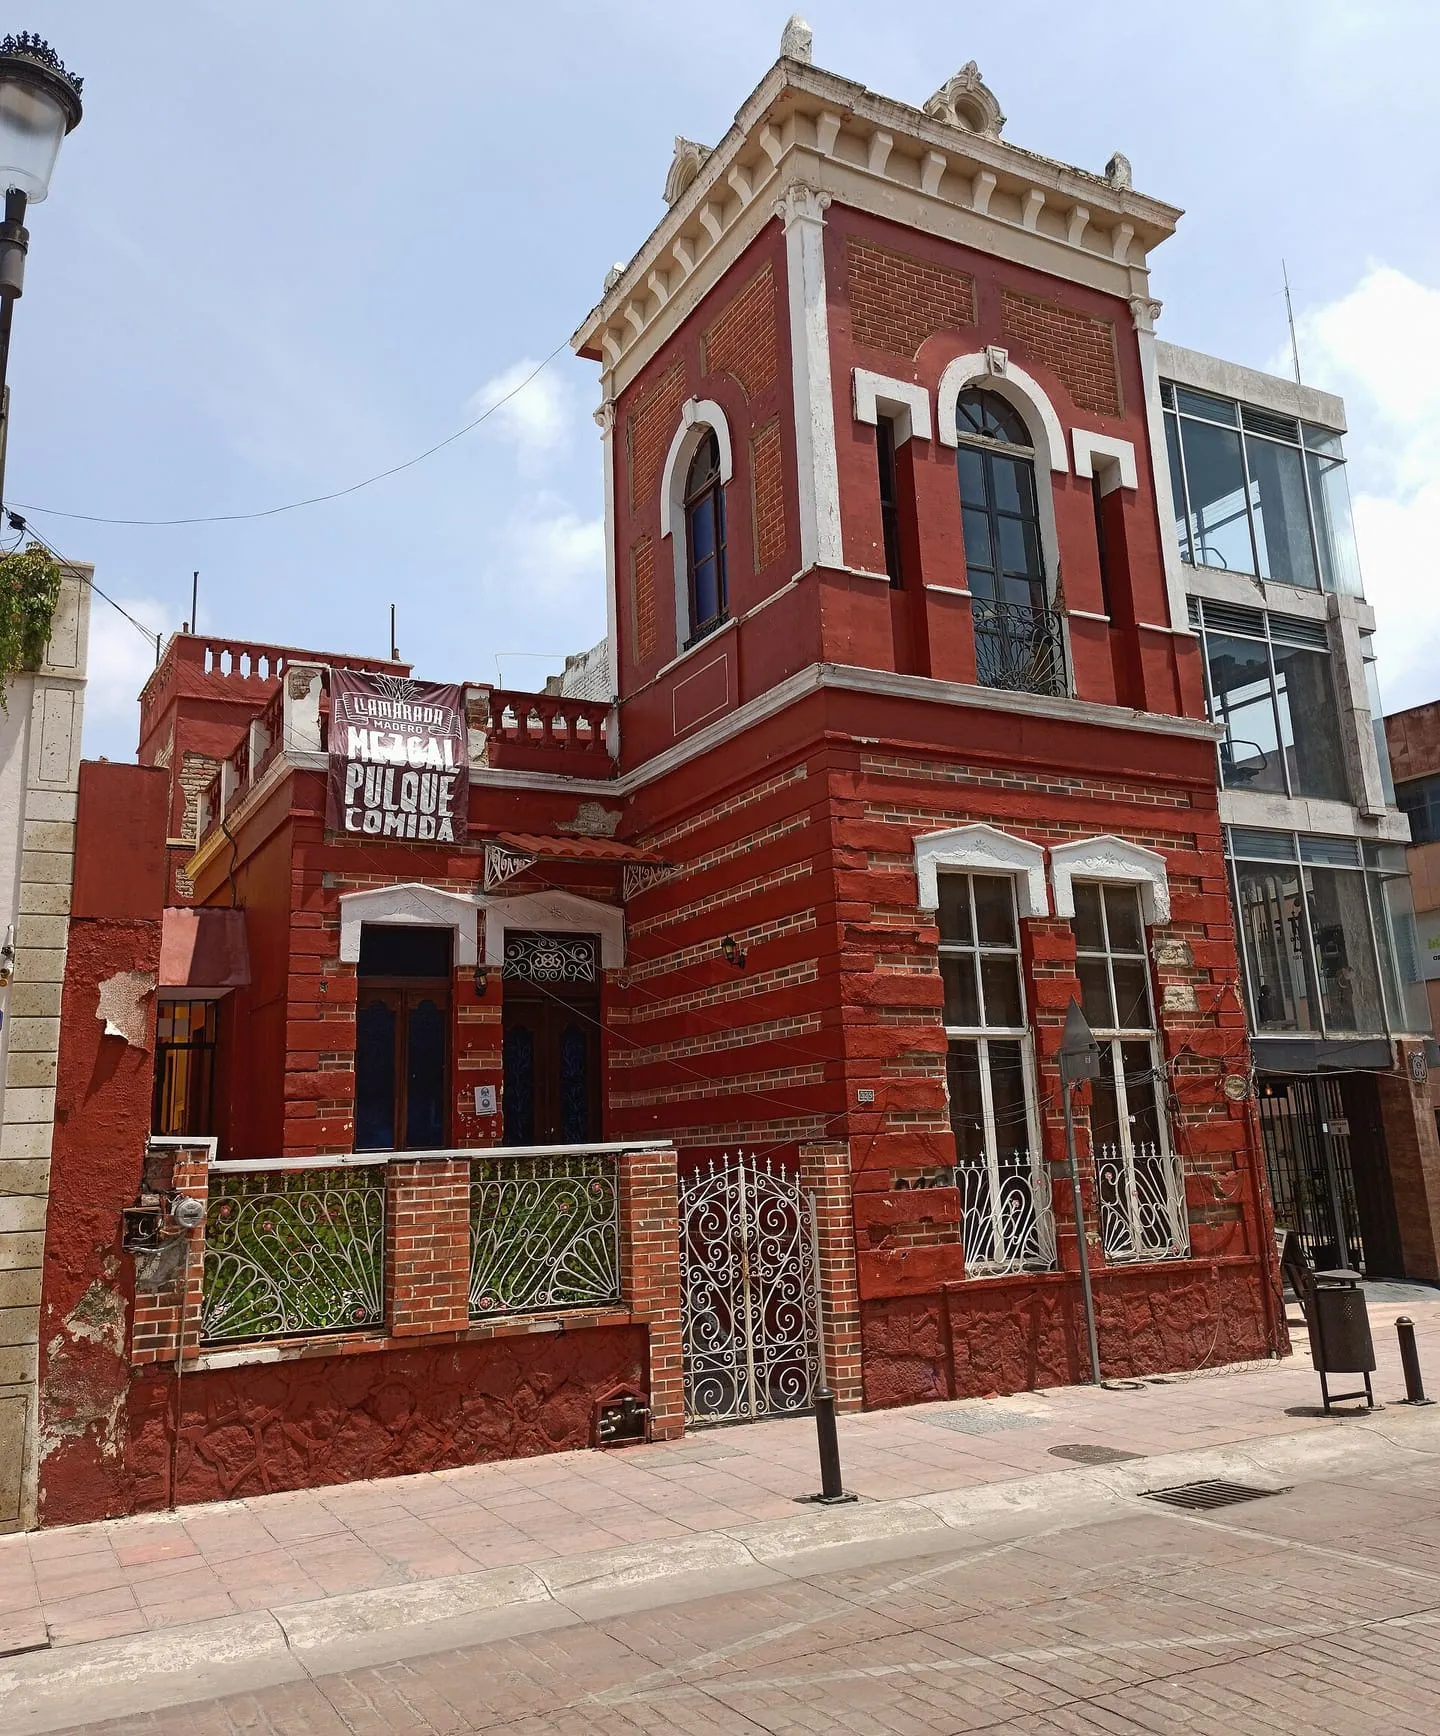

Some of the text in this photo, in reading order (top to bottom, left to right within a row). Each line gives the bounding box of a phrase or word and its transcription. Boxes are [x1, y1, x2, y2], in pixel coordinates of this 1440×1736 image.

[353, 697, 443, 726] LLAMARADA
[373, 720, 423, 734] MADERO
[348, 726, 460, 774] MEZCAL
[345, 763, 456, 817] PULQUE
[346, 808, 455, 842] COMIDA
